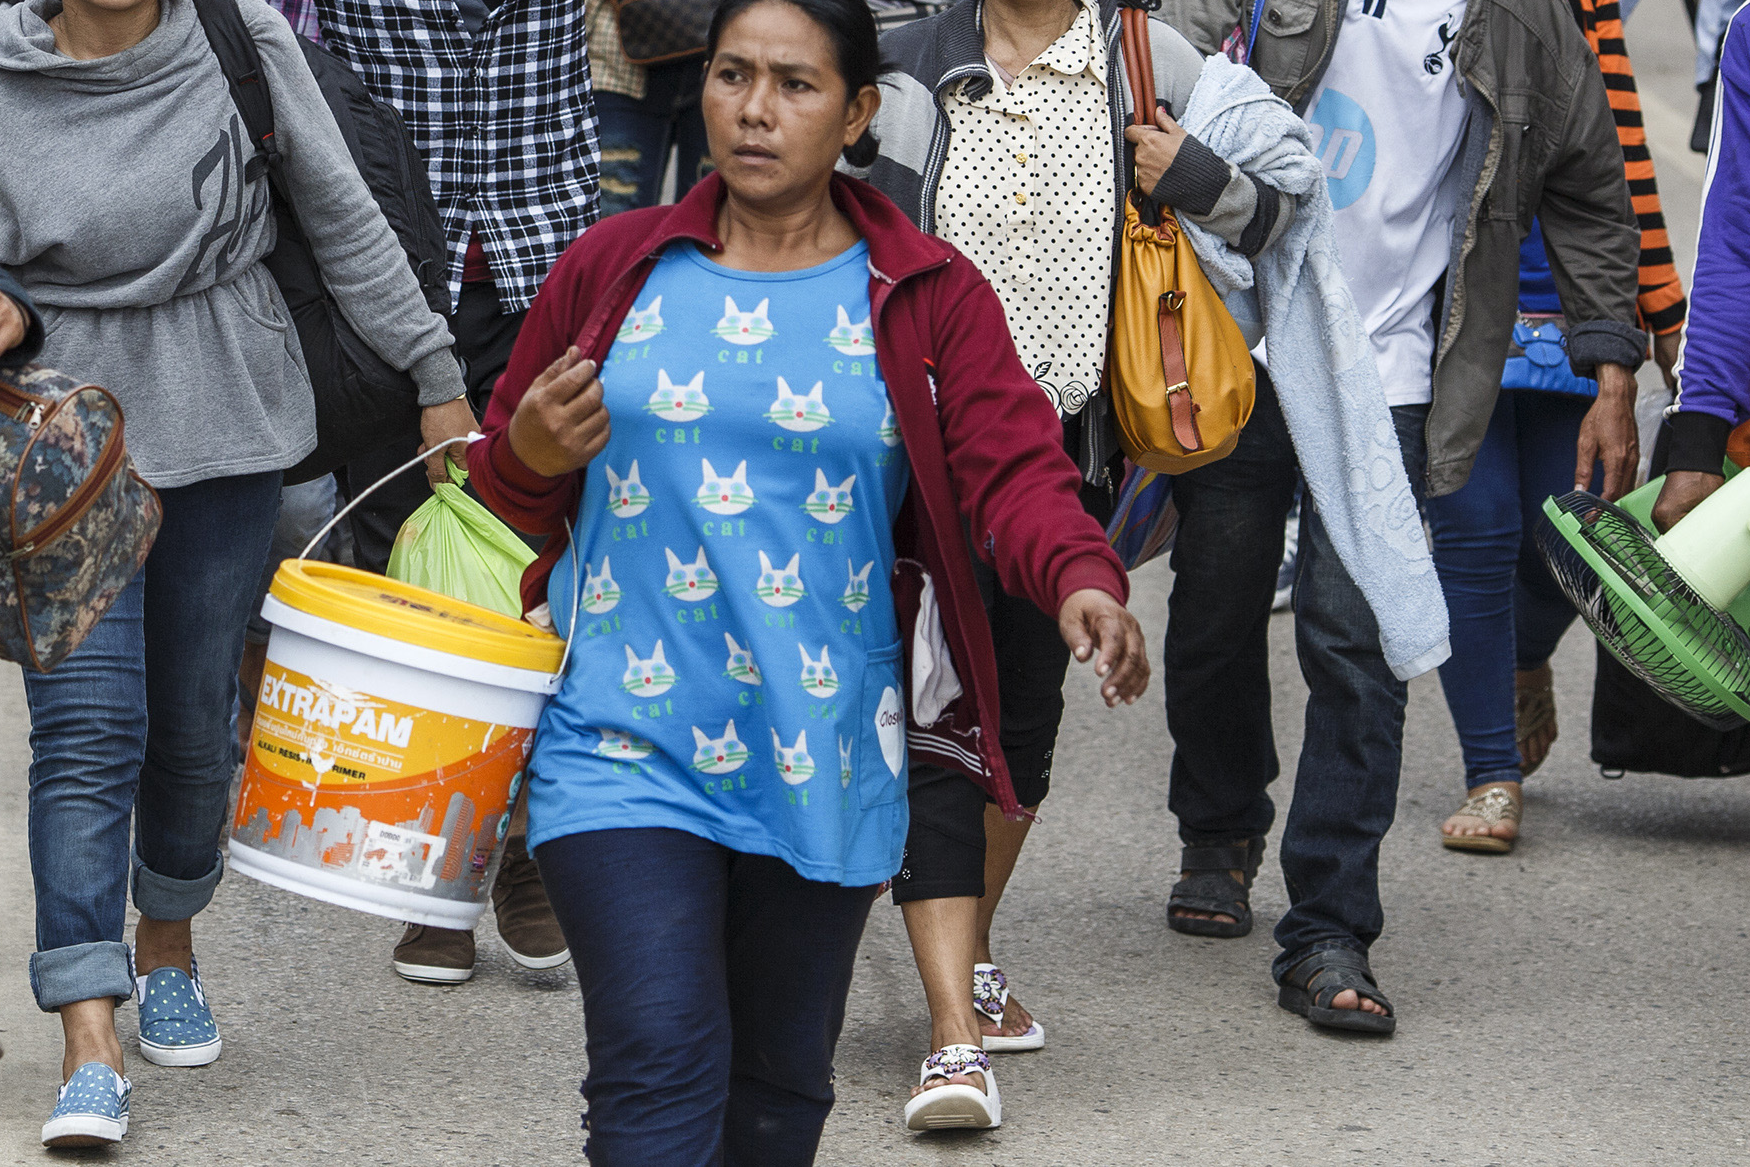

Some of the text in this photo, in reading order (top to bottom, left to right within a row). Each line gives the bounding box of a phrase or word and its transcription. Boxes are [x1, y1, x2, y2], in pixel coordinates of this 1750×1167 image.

[614, 345, 650, 364] cat
[717, 348, 763, 364] cat
[833, 360, 876, 377] cat
[655, 426, 701, 444] cat
[772, 436, 820, 454] cat
[612, 519, 649, 541] cat
[702, 518, 746, 536] cat
[676, 603, 719, 624] cat
[587, 614, 622, 637] cat
[260, 673, 414, 749] EXTRAPAM
[632, 698, 673, 720] cat
[809, 704, 838, 720] cat
[258, 739, 277, 754] ALKALI
[331, 763, 367, 781] RIMER
[704, 773, 748, 795] cat
